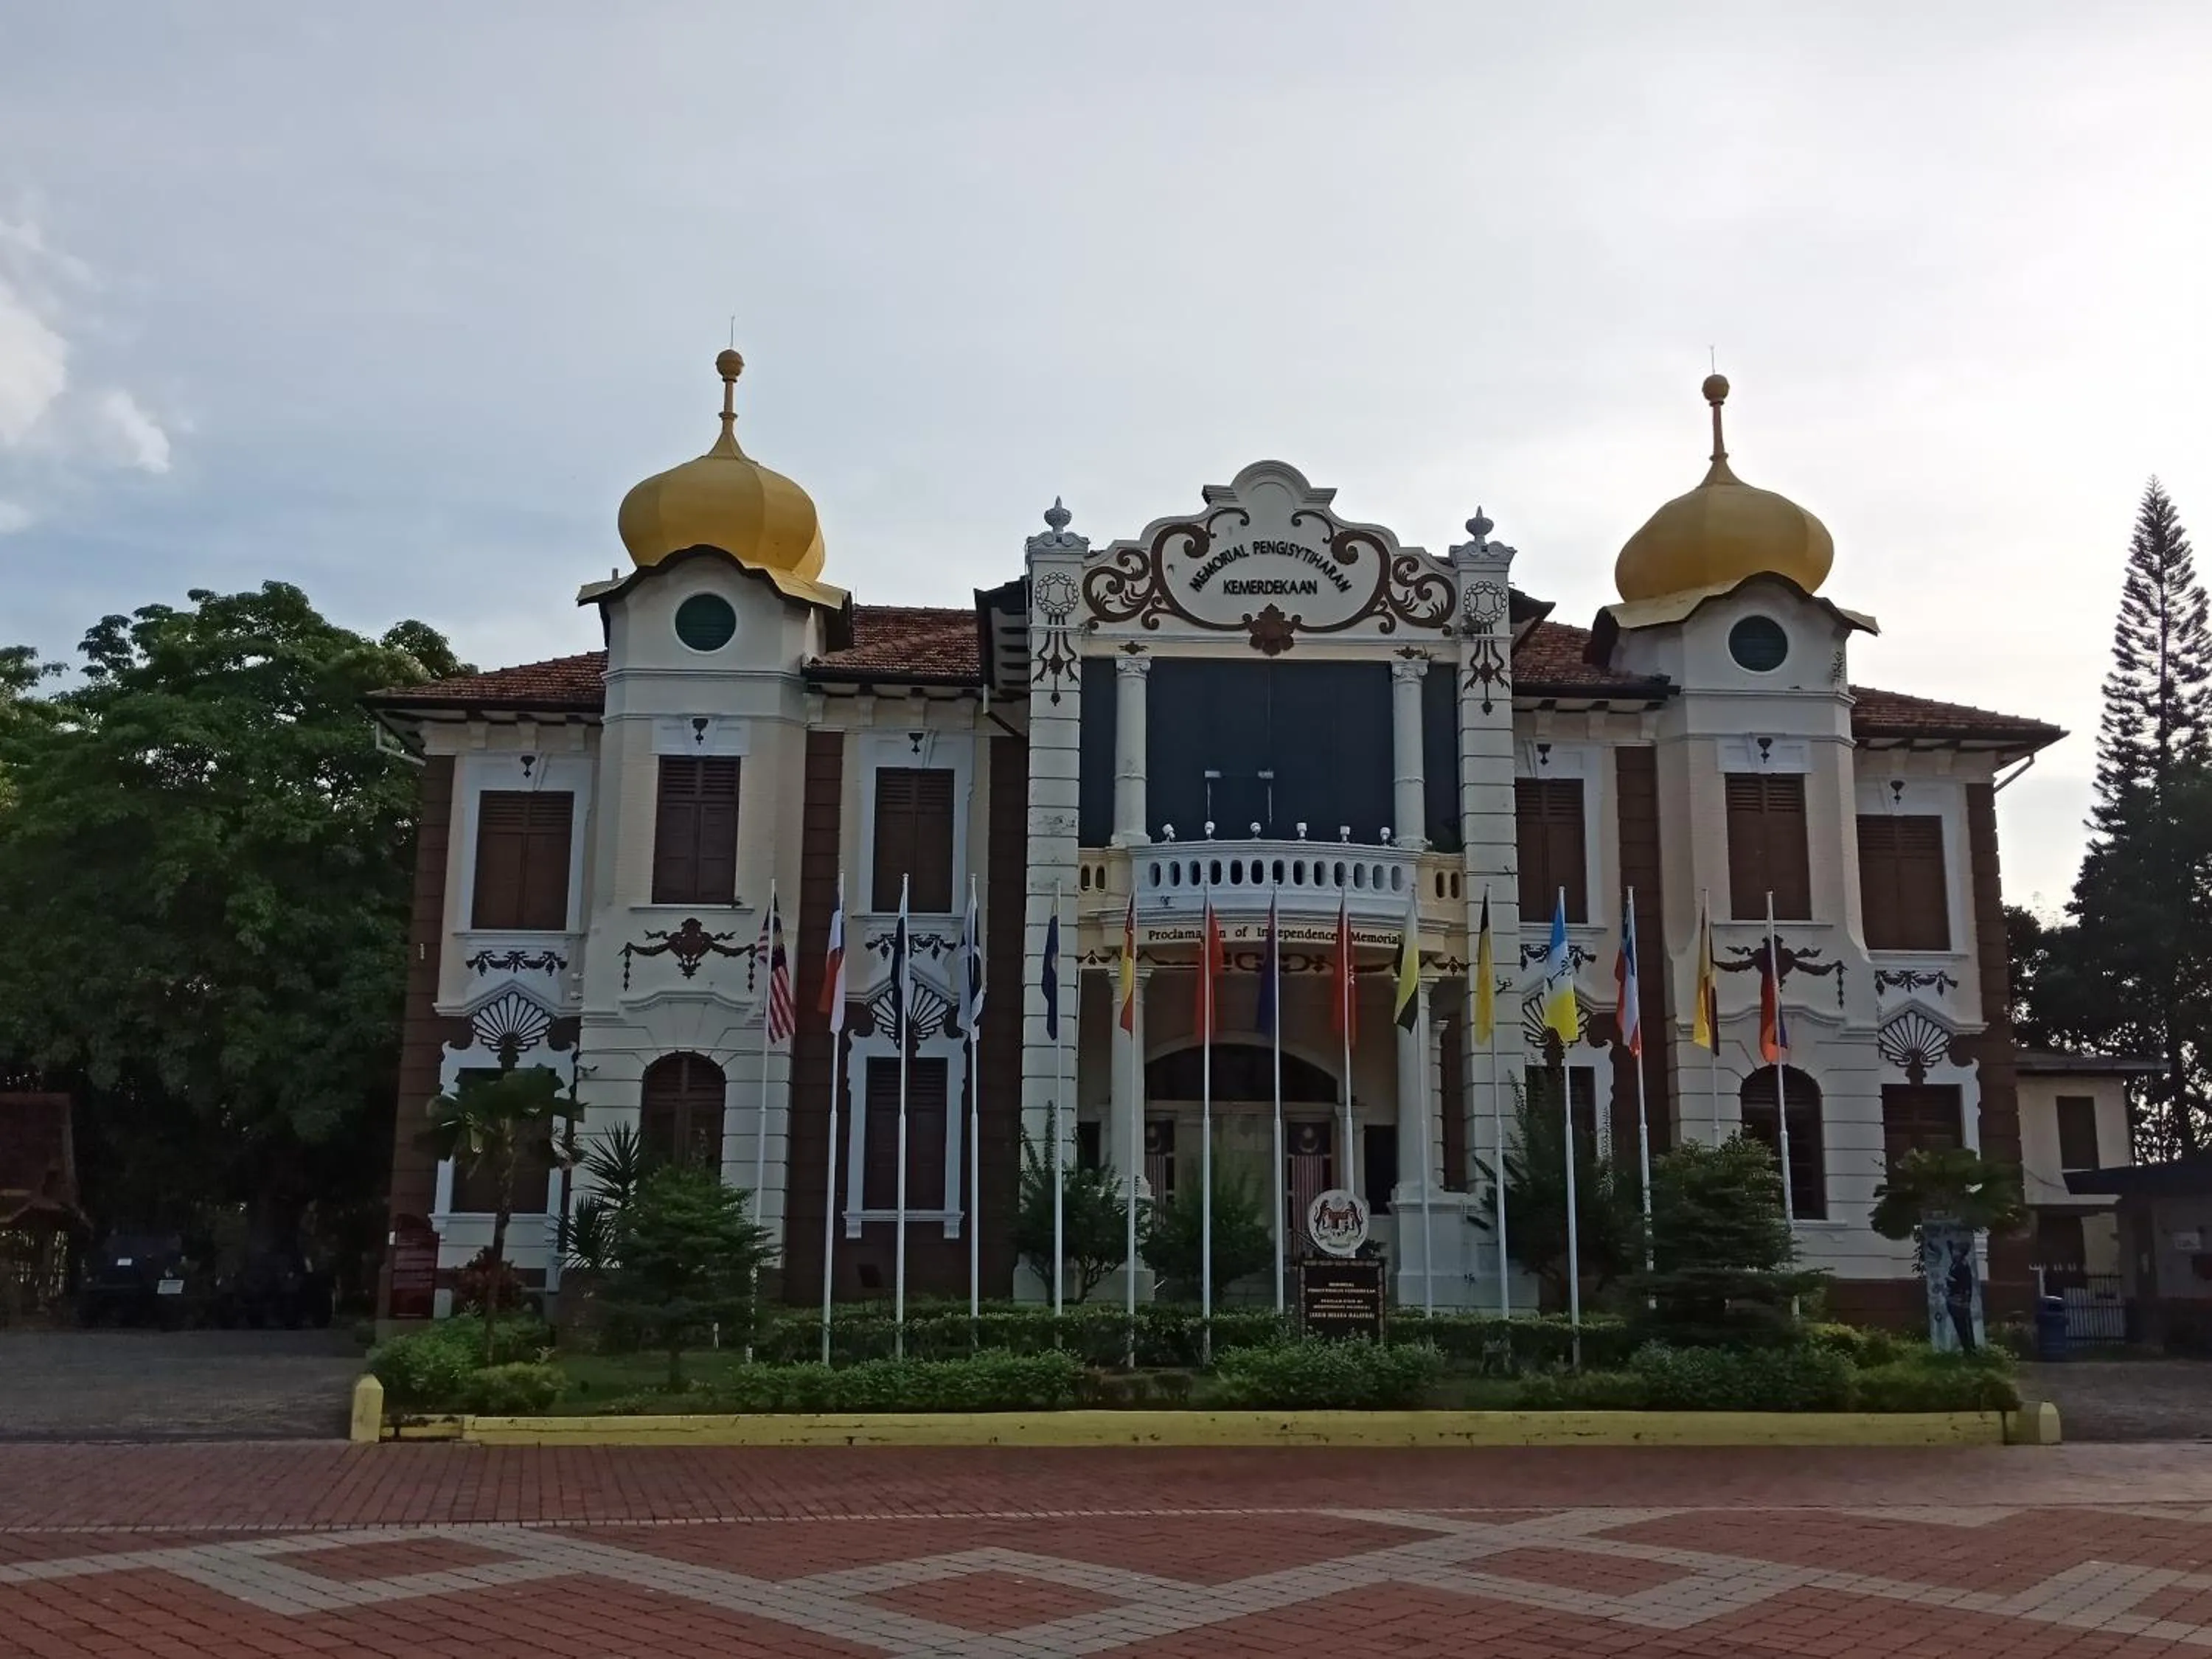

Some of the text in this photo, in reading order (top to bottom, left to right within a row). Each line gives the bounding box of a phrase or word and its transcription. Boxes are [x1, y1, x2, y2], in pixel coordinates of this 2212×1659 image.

[1189, 540, 1352, 594] MEMORIAL PENGISYTIHARAN
[1223, 580, 1318, 594] KEMERDEKAAN
[1148, 929, 1226, 940] Proclaman
[1235, 926, 1248, 937] of
[1257, 927, 1339, 941] Inependence
